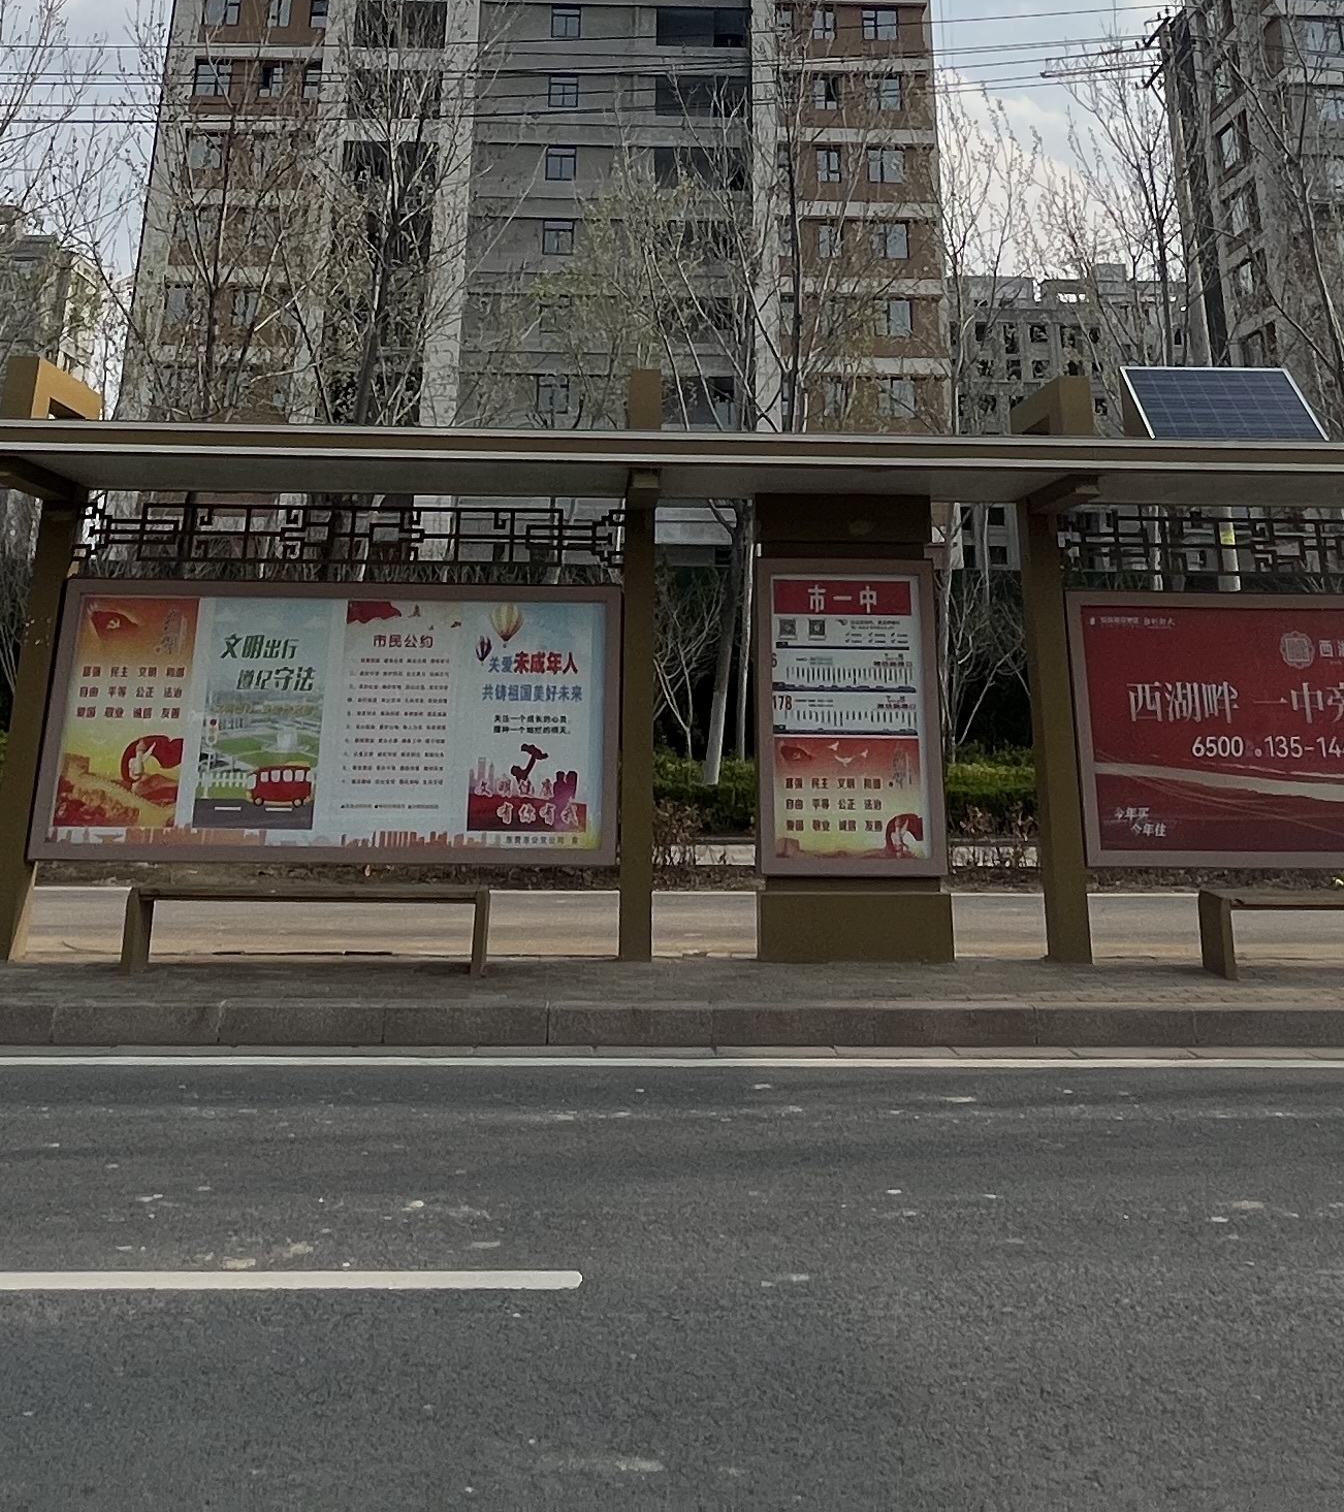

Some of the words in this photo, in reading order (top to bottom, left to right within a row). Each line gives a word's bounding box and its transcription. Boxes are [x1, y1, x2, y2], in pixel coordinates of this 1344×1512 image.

[807, 584, 878, 614] 市一中
[220, 633, 299, 659] 文明出行
[373, 634, 434, 648] 市民公约
[488, 650, 578, 675] 关爱未成年人
[236, 666, 316, 691] 遵纪守法
[482, 684, 582, 702] 共铸祖国美好未来
[1126, 681, 1240, 724] 西湖畔
[1191, 736, 1244, 758] 6500
